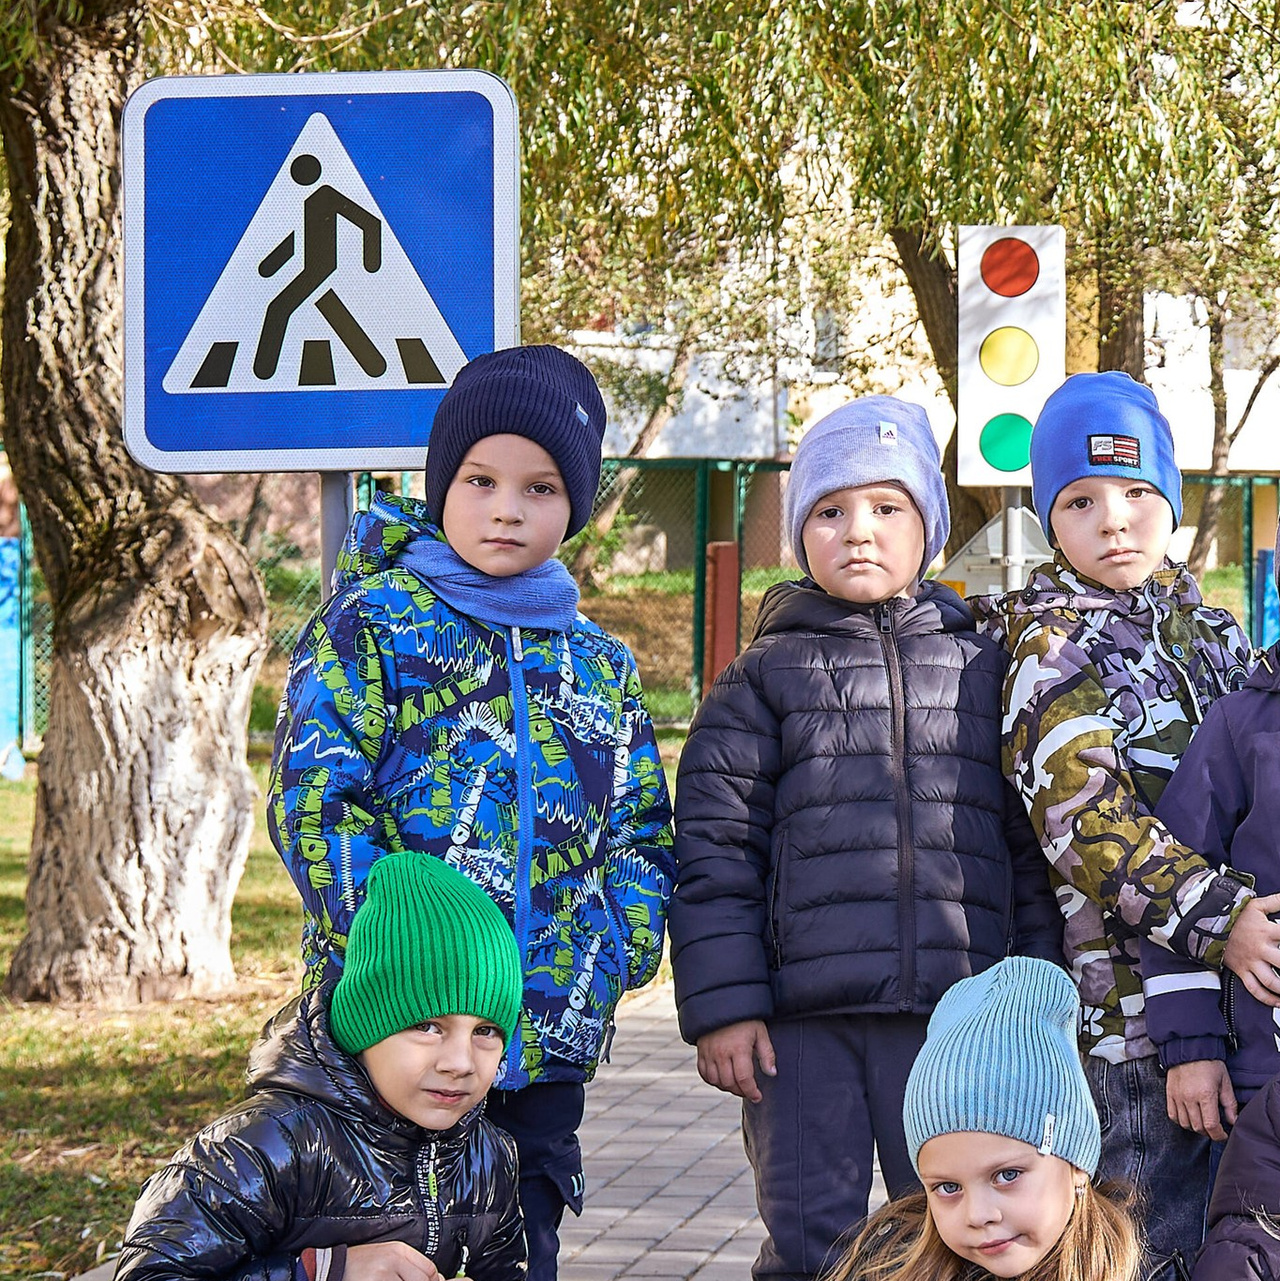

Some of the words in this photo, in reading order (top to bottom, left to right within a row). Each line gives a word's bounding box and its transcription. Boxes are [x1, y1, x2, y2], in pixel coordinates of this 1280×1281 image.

[1093, 440, 1113, 452] FS
[1113, 456, 1139, 466] SPORT
[294, 765, 333, 890] BOARD
[425, 1221, 435, 1255] CONTROL
